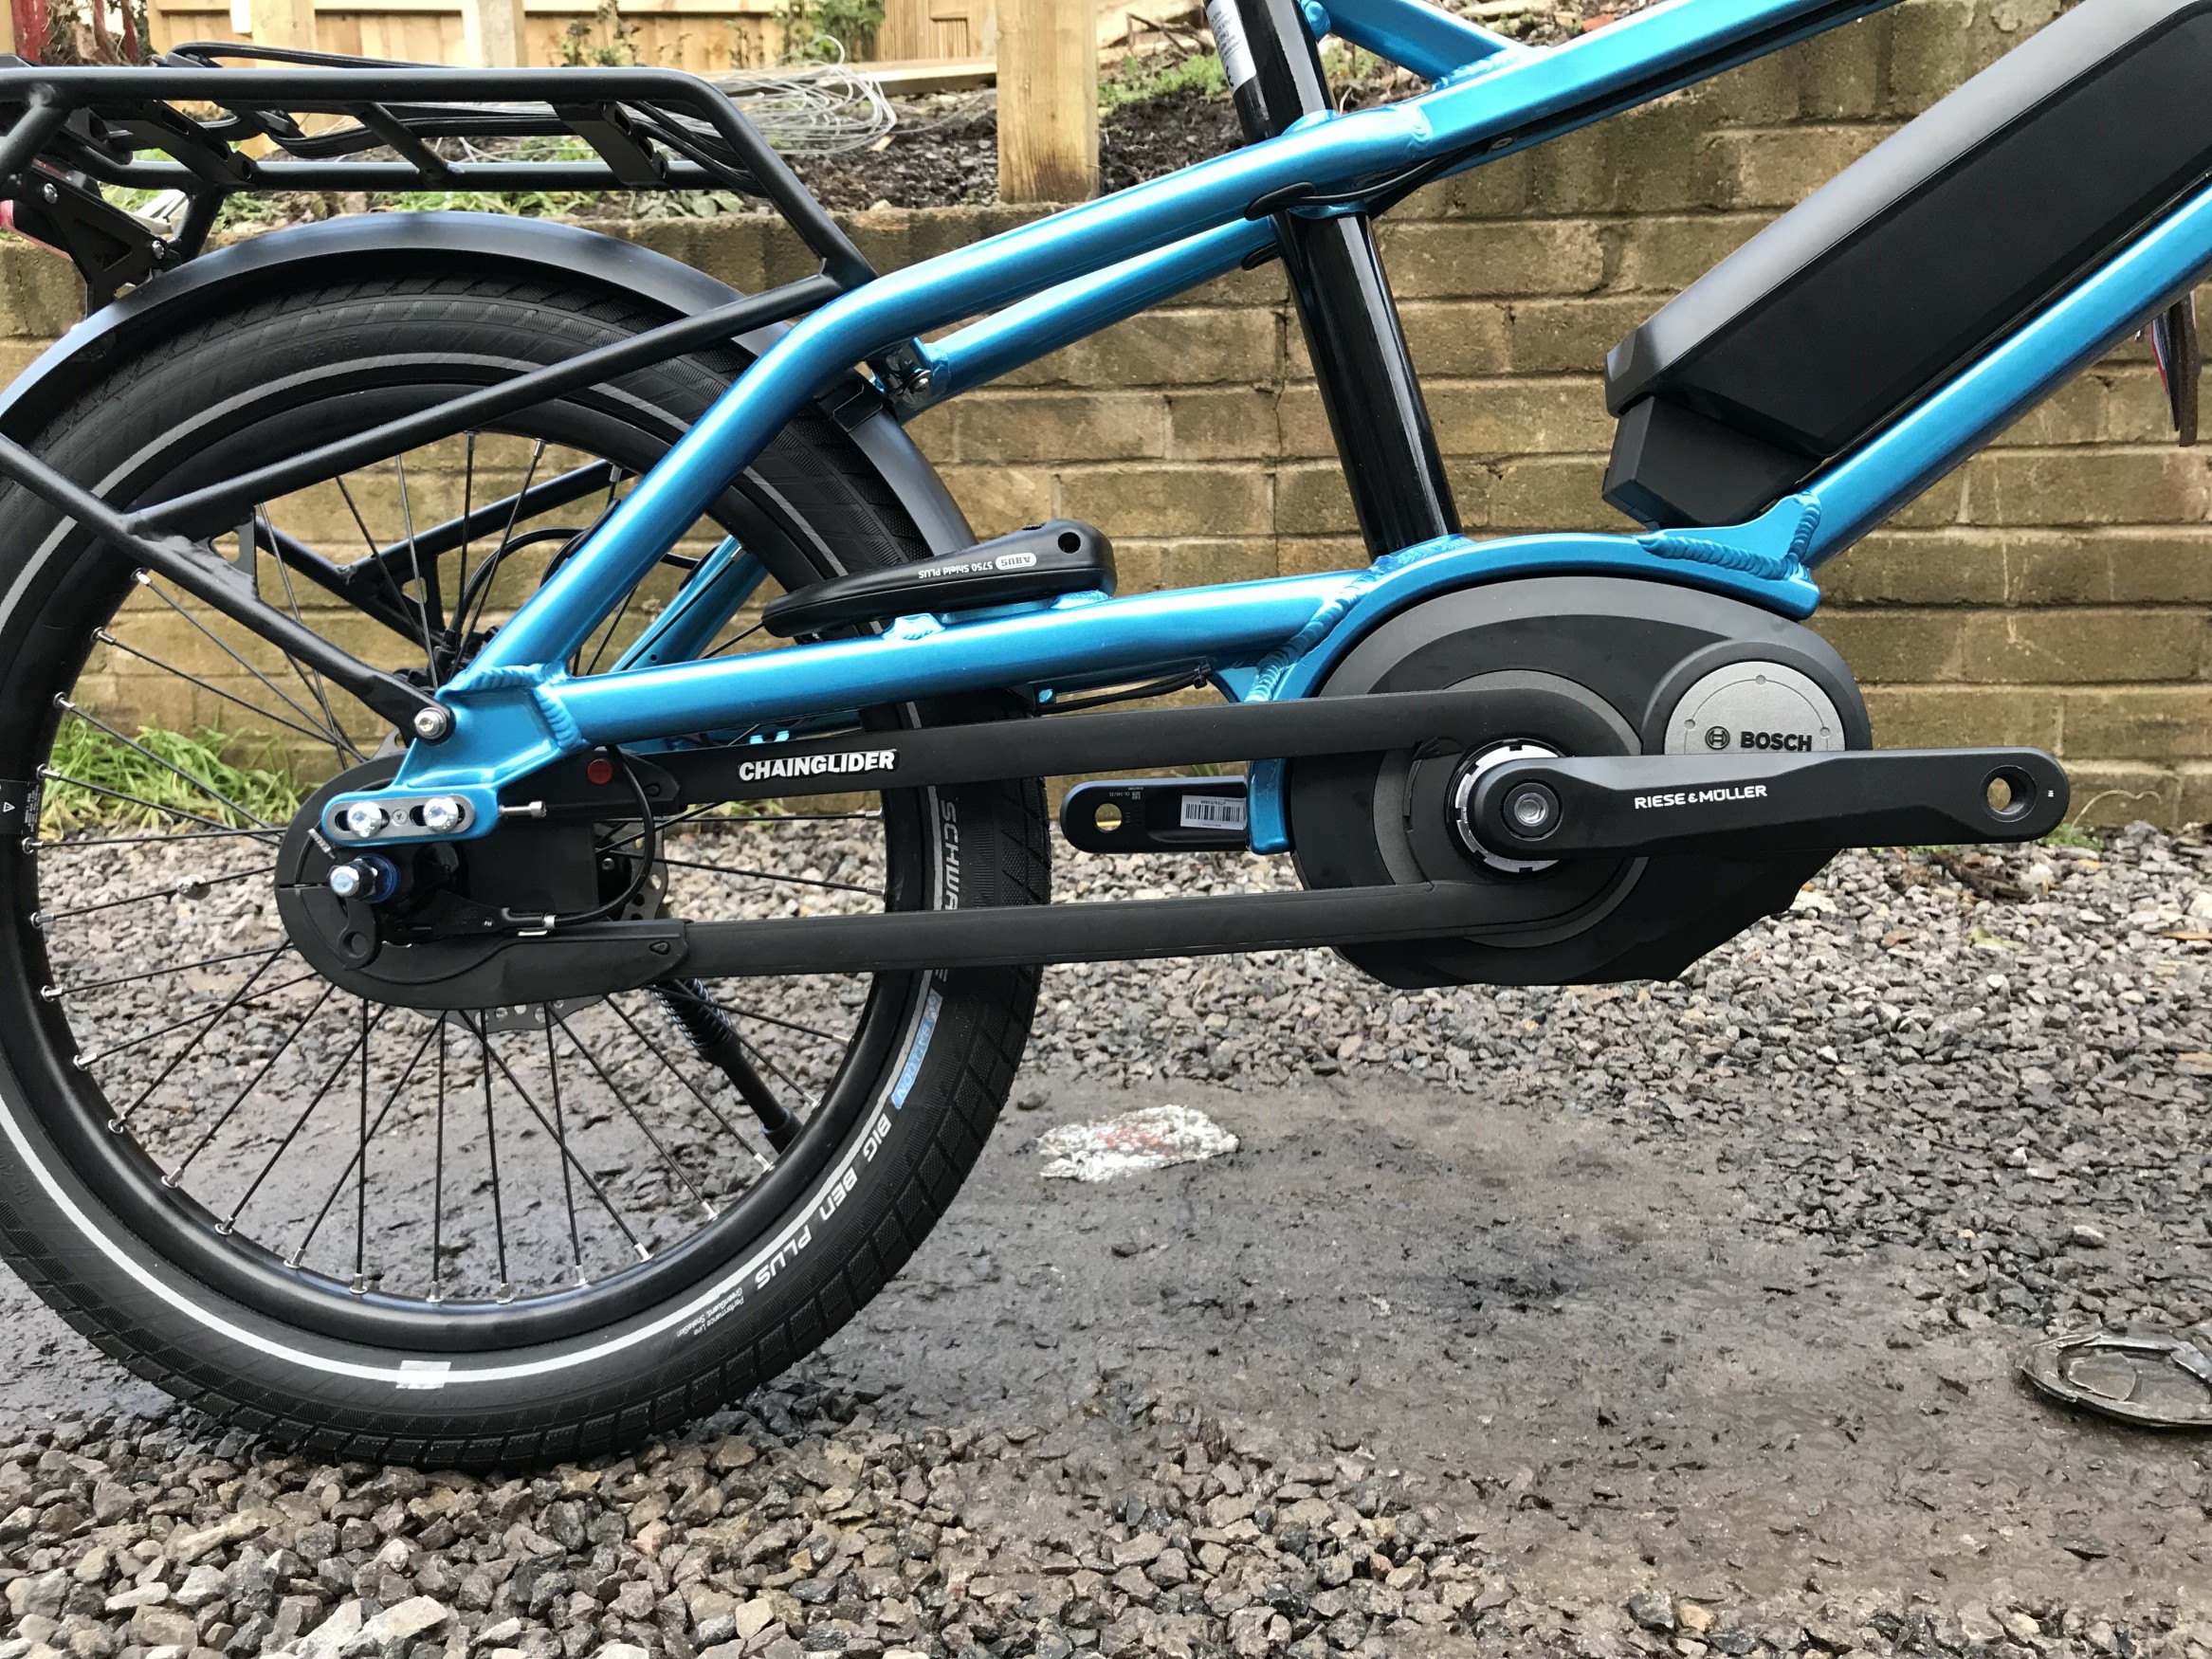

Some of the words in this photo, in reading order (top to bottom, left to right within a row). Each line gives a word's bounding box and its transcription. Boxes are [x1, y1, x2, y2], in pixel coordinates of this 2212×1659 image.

[942, 564, 970, 575] Shield
[971, 560, 994, 572] 5750
[1001, 556, 1031, 567] ABUS
[918, 568, 941, 579] PLUS
[1741, 731, 1813, 752] BOSCH
[738, 751, 897, 782] CHAINGLIDER
[1634, 793, 1687, 810] RIESE
[1698, 785, 1768, 803] MÜLLER
[897, 1023, 931, 1100] BALLOON
[861, 1113, 890, 1162] BIG
[755, 1224, 813, 1290] PLUS
